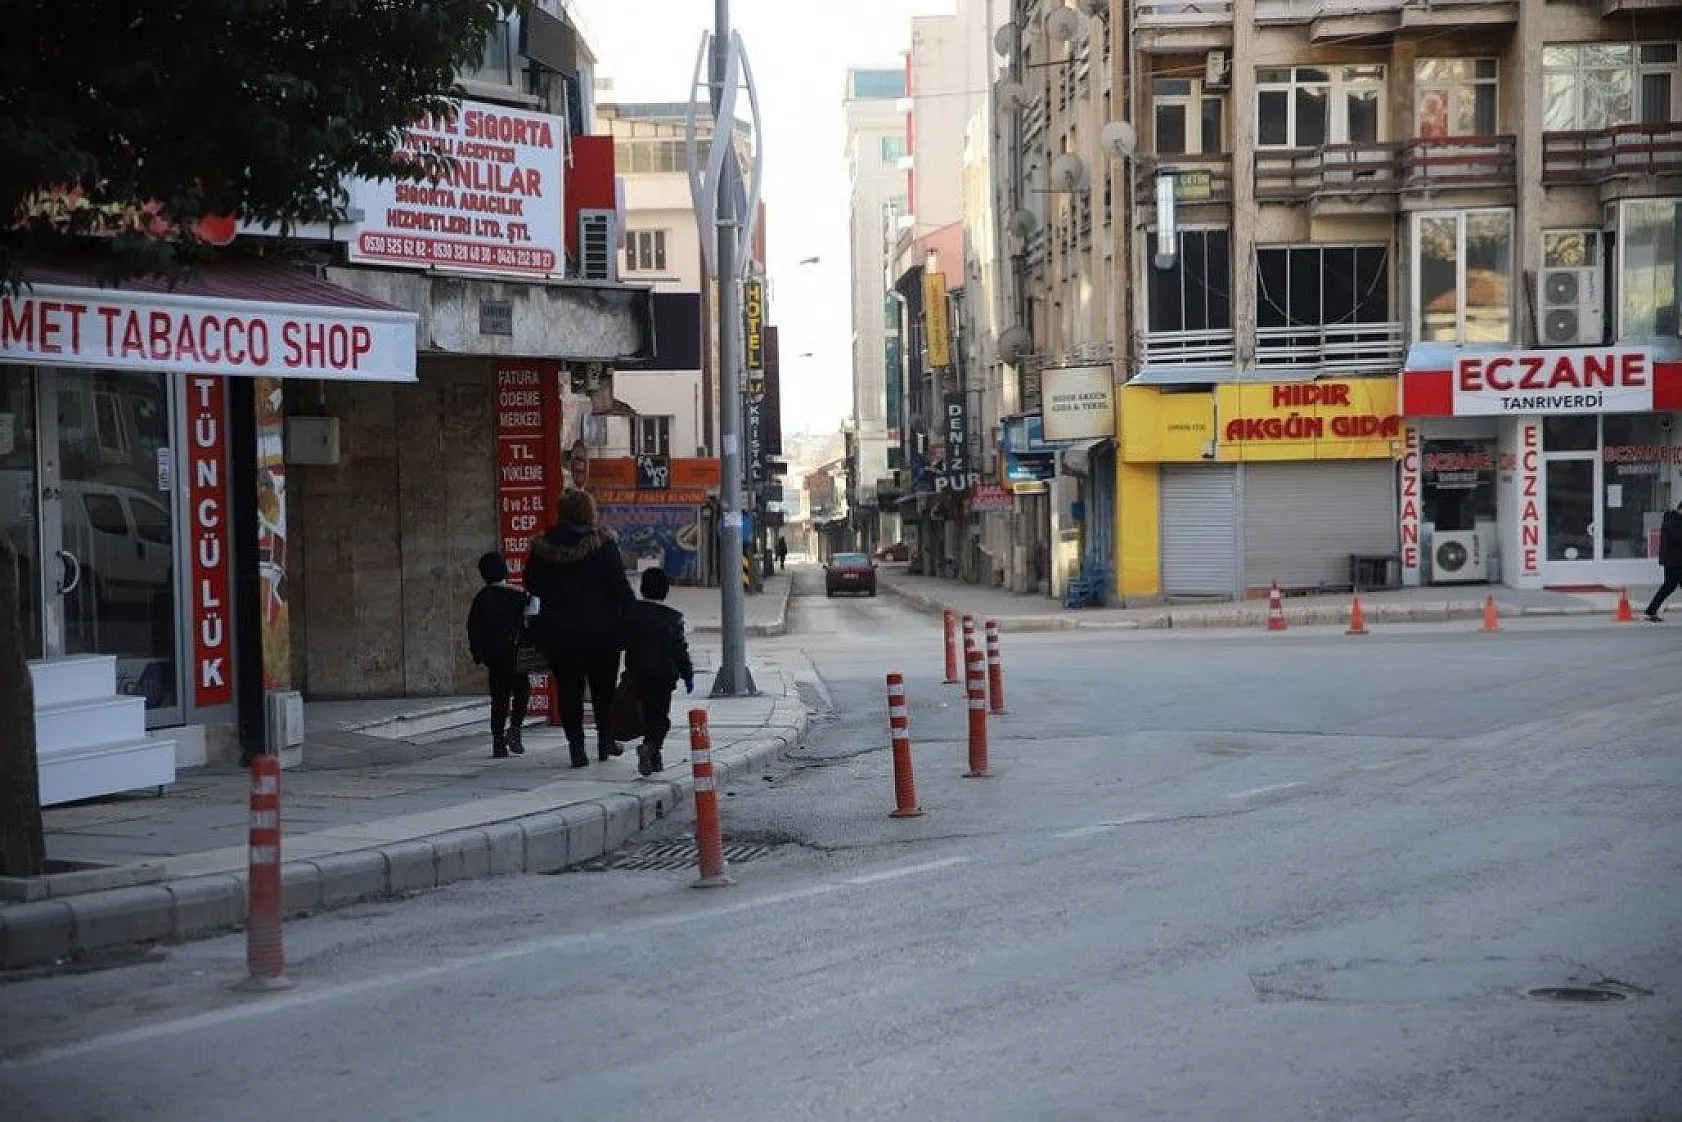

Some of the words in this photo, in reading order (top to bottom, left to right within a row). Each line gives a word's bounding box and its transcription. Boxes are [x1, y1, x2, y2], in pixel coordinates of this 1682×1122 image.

[475, 219, 504, 238] LTD.
[1, 299, 87, 355] MET
[98, 306, 270, 366] TABACCO
[283, 320, 372, 370] SHOP
[747, 285, 761, 369] HOTEL
[498, 370, 540, 385] FATURA
[1458, 352, 1646, 392] ECZANE
[500, 387, 540, 406] ÖDEME
[1272, 384, 1350, 407] HIDIR
[1501, 389, 1603, 411] TANRIVERDİ
[1226, 412, 1323, 441] AKGÜN
[1330, 414, 1403, 438] GIDA
[509, 444, 534, 459] TL
[935, 472, 981, 493] PUR
[1400, 426, 1418, 569] ECZANE
[1522, 425, 1539, 571] ECZANE
[194, 378, 225, 689] TÜNCÜLÜK
[511, 516, 537, 531] CEP
[504, 536, 530, 552] TELEF
